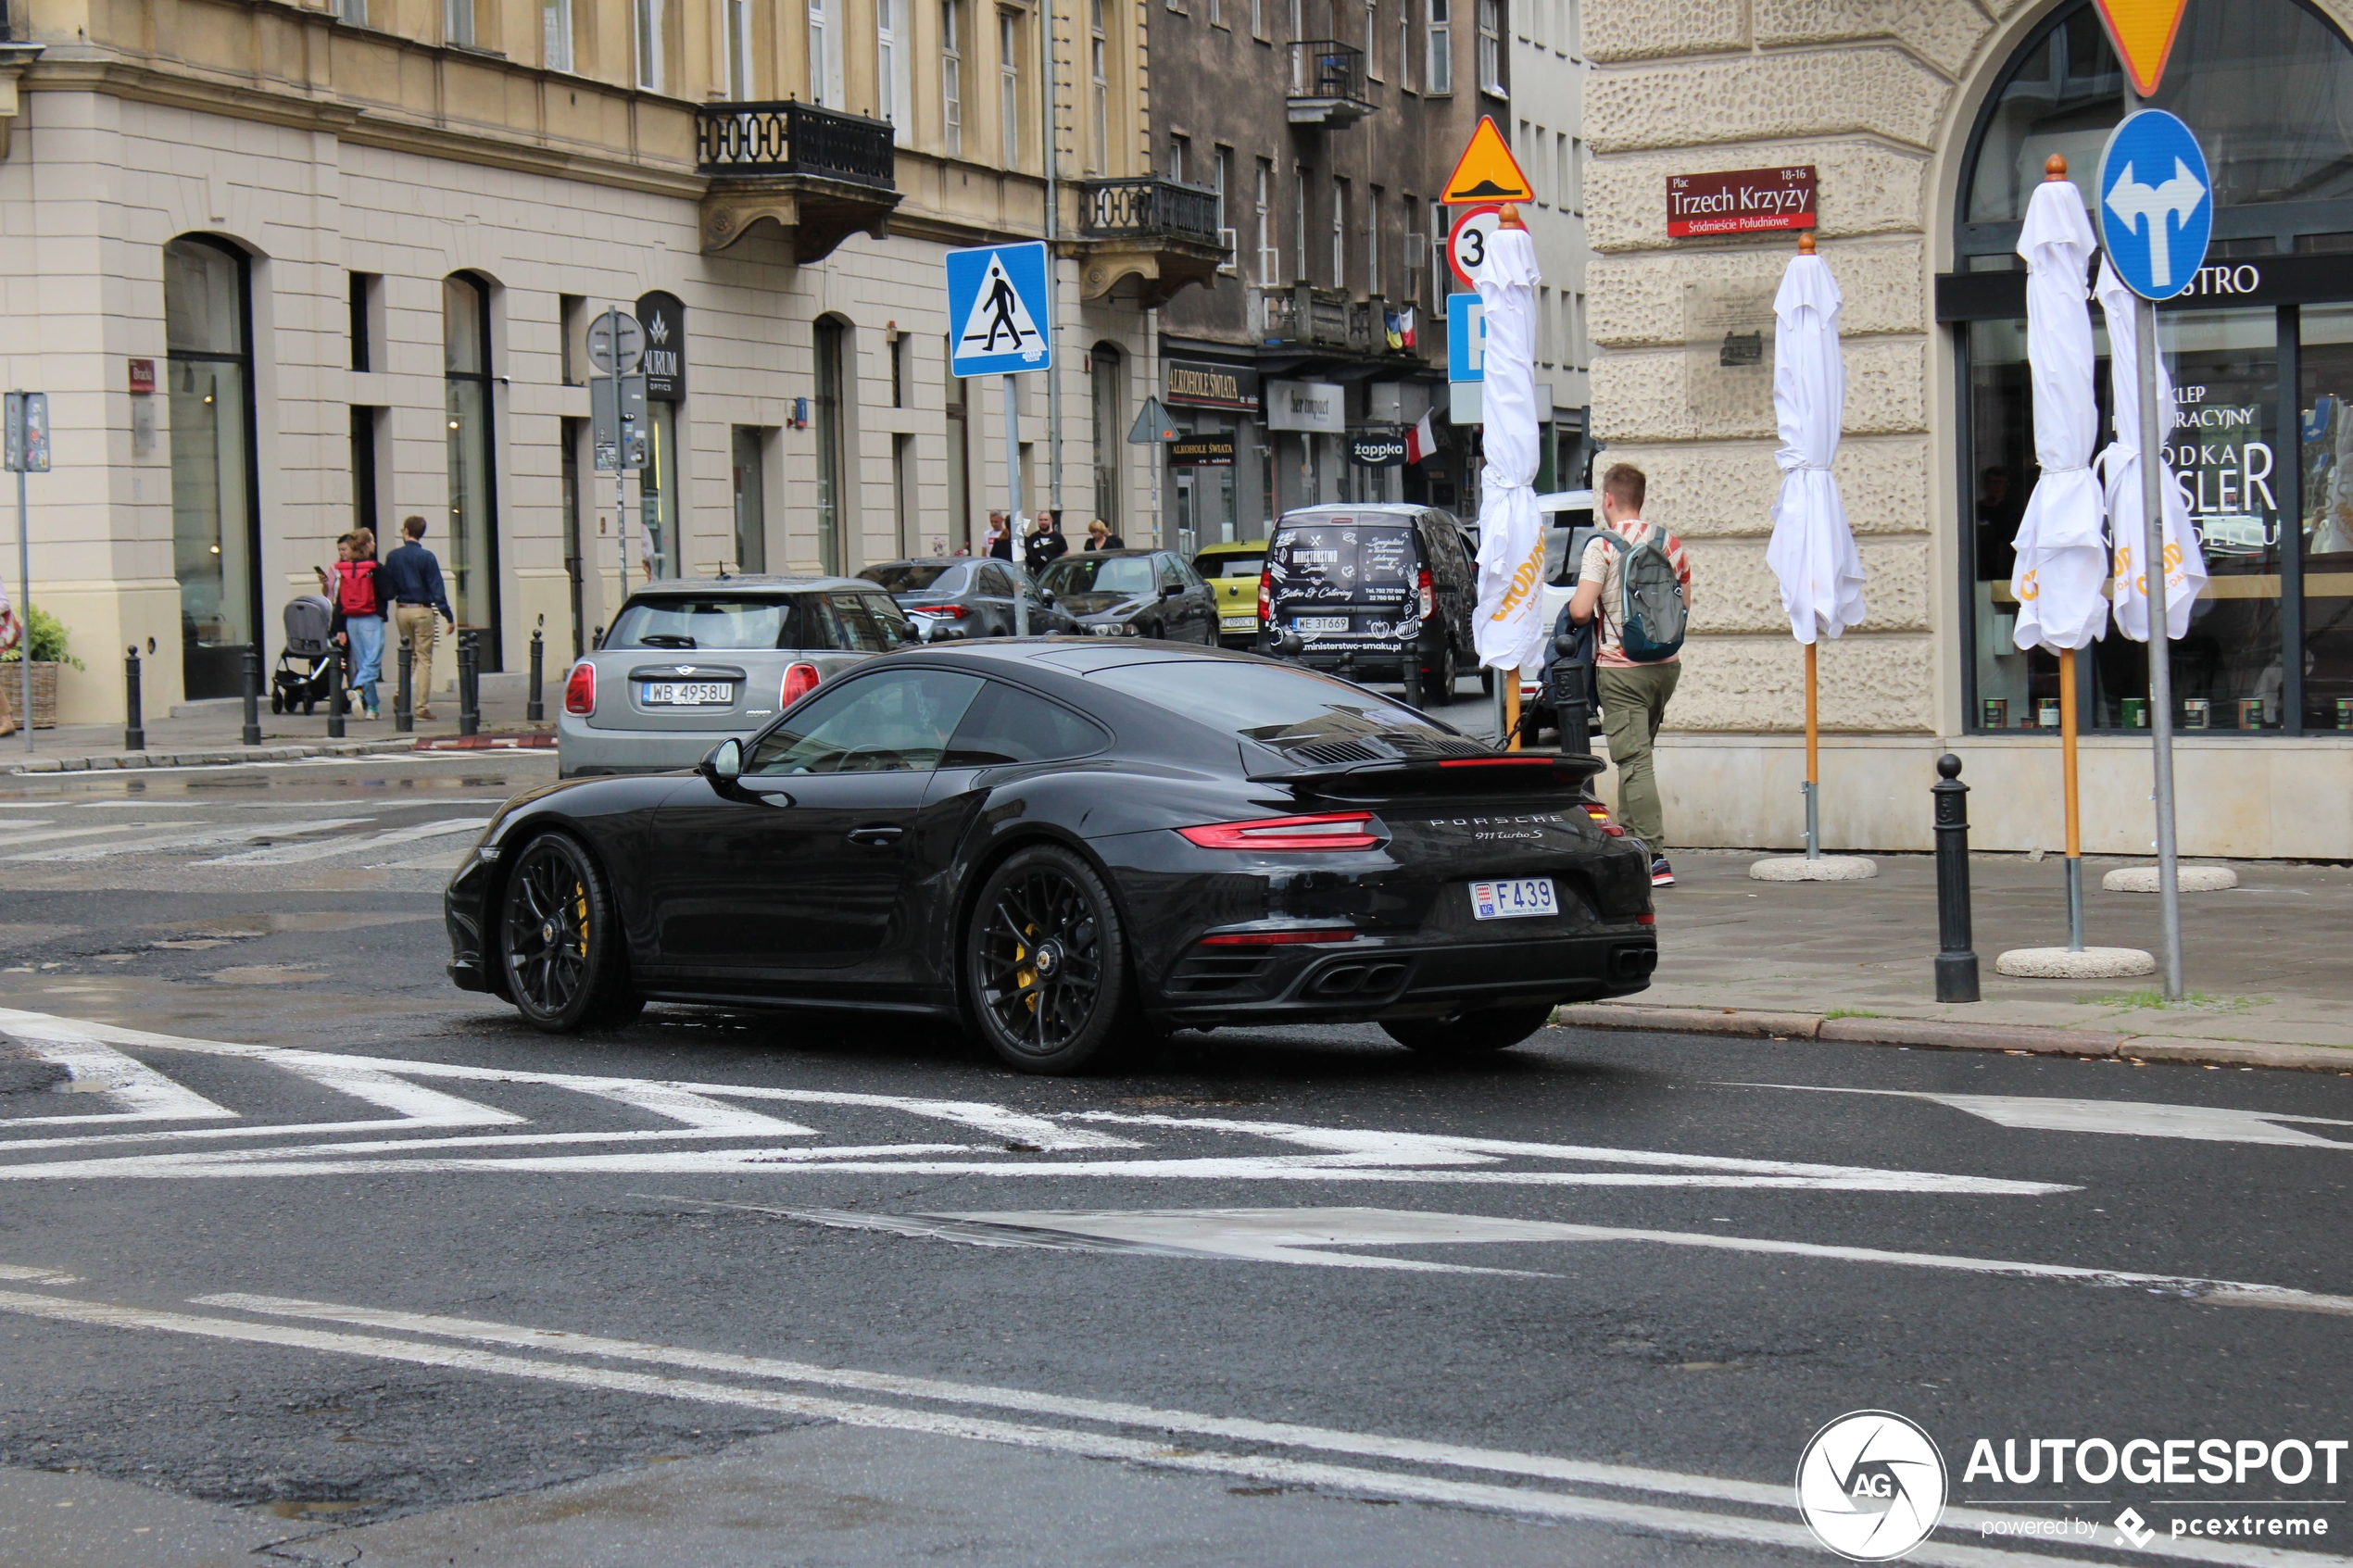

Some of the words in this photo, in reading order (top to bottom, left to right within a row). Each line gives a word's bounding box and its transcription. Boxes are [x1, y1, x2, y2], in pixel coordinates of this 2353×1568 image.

[1673, 178, 1689, 188] Plac
[1780, 169, 1806, 181] 18-16
[1671, 186, 1734, 215] Trzech
[1740, 182, 1809, 215] Krzyży
[1689, 220, 1737, 232] Śródmieście
[1740, 217, 1789, 229] Południowe
[645, 350, 677, 376] AURUM
[649, 383, 672, 392] OPTICS
[1167, 368, 1210, 396] ALKOHOLE
[1210, 368, 1238, 399] ŚWIATA
[2172, 385, 2206, 405] KLEP
[1173, 445, 1206, 454] ALKOHOLE
[1209, 442, 1233, 454] ŚWIATA
[1354, 443, 1403, 457] żappka
[2161, 442, 2238, 467] ÓDKA
[1293, 550, 1337, 563] MINISTERSTWO
[1277, 587, 1304, 600] Bistro
[1318, 586, 1353, 601] Catering
[1299, 619, 1312, 629] WE
[1315, 618, 1346, 629] 3T669
[653, 685, 673, 700] WB
[679, 685, 729, 700] 4958U
[1430, 815, 1564, 827] PORSCHE
[1475, 832, 1494, 840] 911
[1530, 830, 1542, 839] S
[1496, 883, 1507, 909] F
[1514, 881, 1551, 908] 439
[1481, 905, 1492, 913] MC
